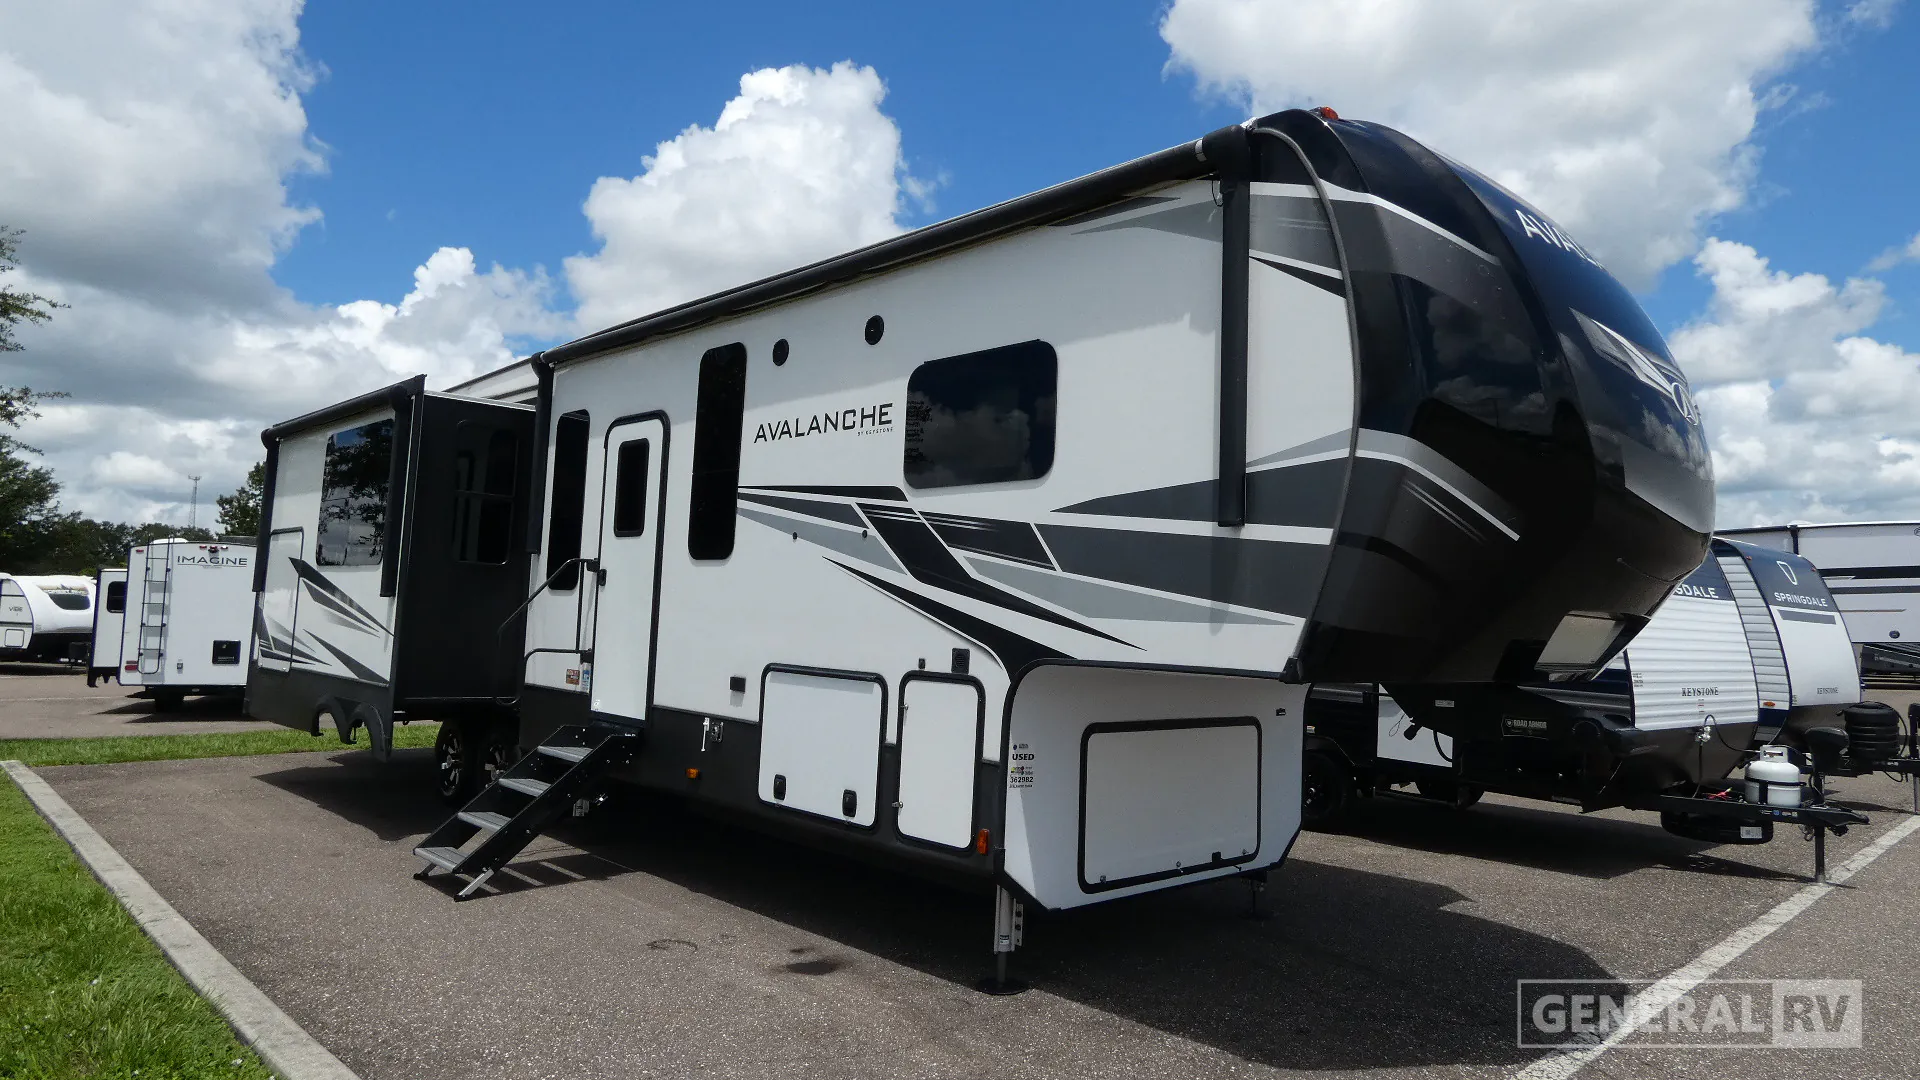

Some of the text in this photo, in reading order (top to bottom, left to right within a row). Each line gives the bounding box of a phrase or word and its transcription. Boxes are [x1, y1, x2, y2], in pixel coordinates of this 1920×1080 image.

[1515, 209, 1604, 269] AVAL
[754, 402, 893, 444] AVALANCHE
[177, 555, 248, 566] IMAGINE
[1774, 592, 1828, 607] SPRINGDALE
[1681, 686, 1719, 697] KEYSTONE
[1513, 719, 1528, 728] ROAD
[1012, 753, 1035, 761] USED
